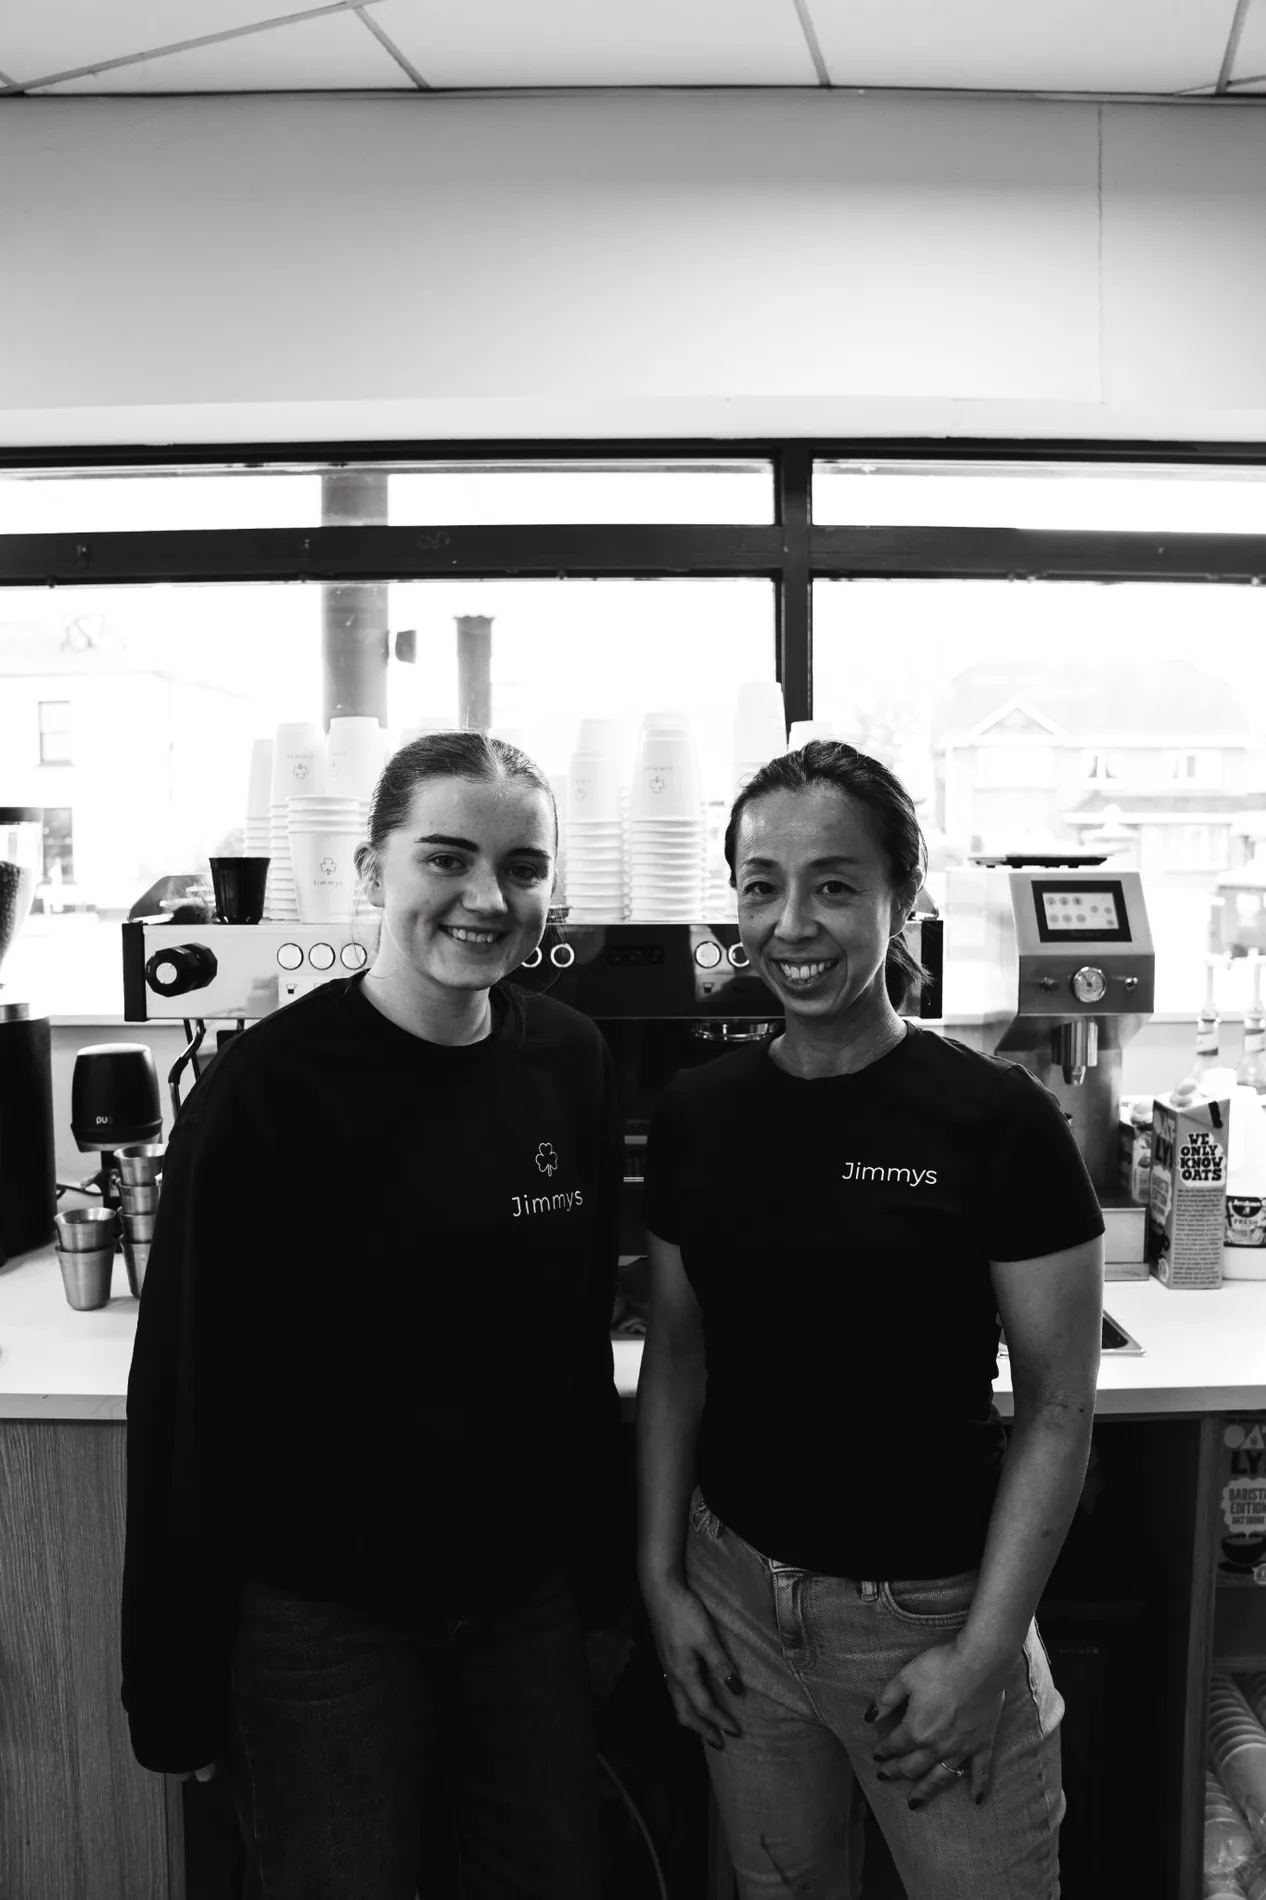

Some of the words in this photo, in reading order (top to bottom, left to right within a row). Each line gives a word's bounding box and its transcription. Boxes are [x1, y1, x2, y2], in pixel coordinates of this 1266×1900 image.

[1188, 1132, 1209, 1145] WE
[1180, 1145, 1218, 1157] ONLY
[1180, 1156, 1224, 1169] KNOW
[842, 1161, 938, 1187] Jimmys
[1182, 1167, 1222, 1181] OATS
[511, 1190, 584, 1217] Jimmys
[1231, 1451, 1266, 1475] LY
